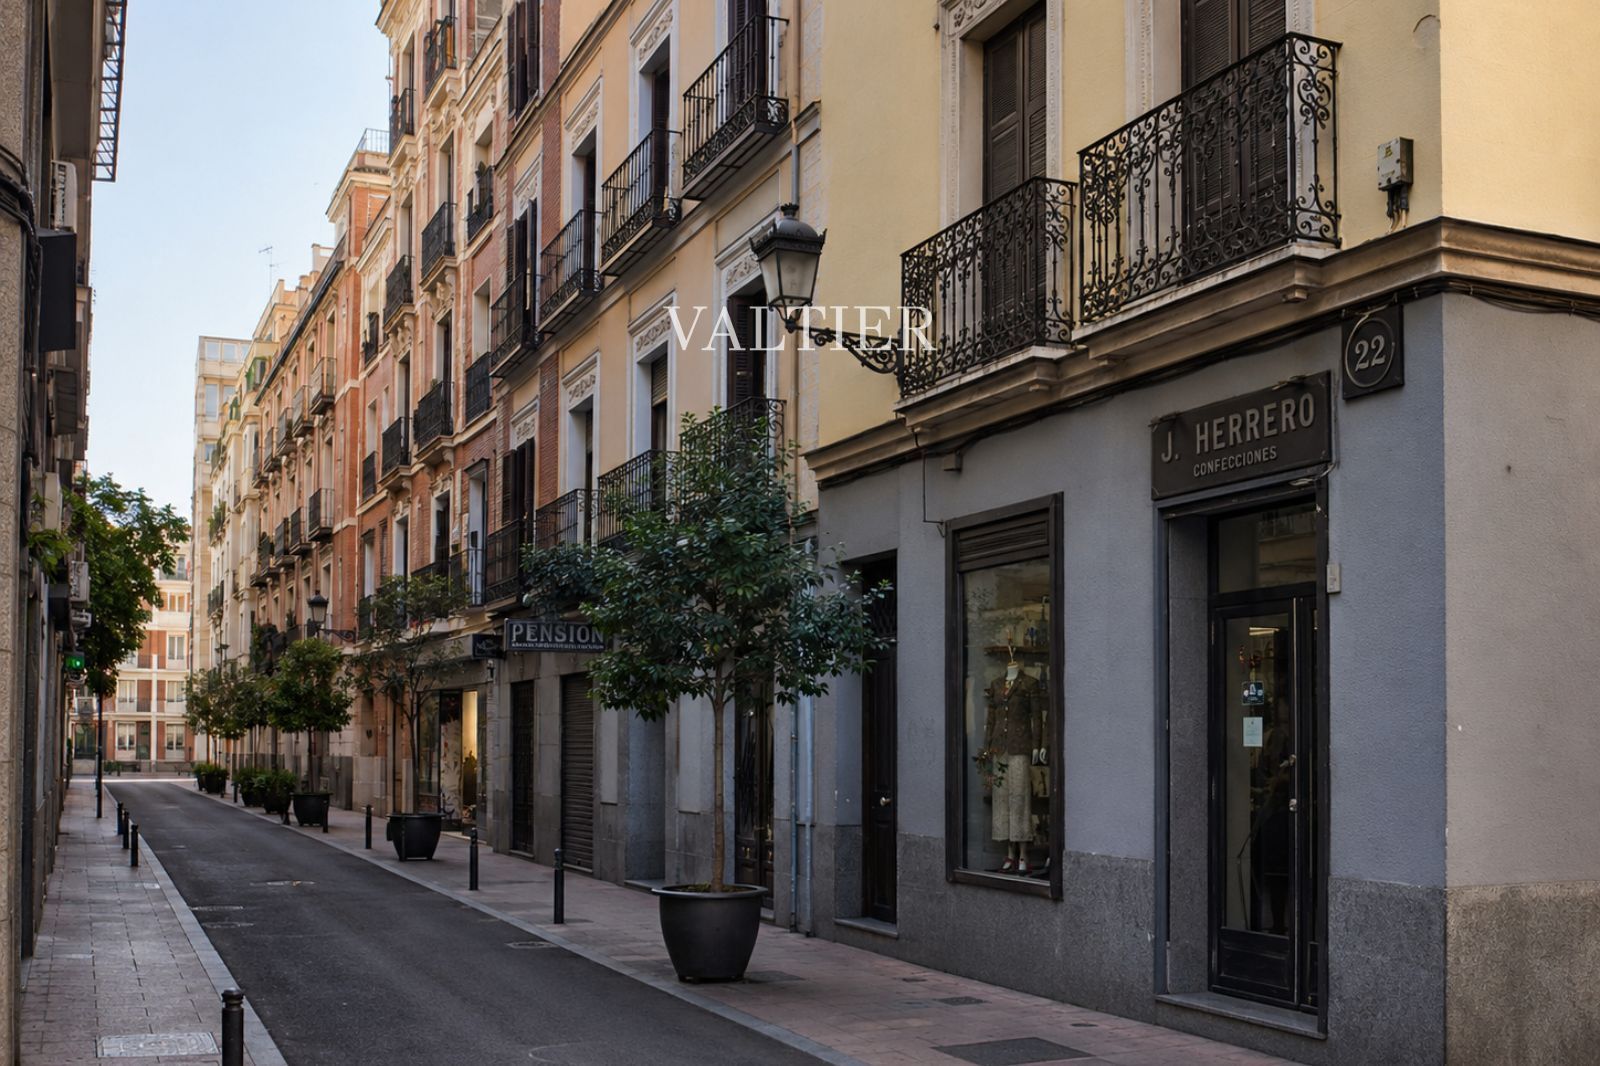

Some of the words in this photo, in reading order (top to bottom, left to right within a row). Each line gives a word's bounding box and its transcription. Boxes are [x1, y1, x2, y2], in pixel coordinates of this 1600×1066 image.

[1354, 335, 1386, 372] 22
[1161, 431, 1180, 463] J.
[1196, 393, 1315, 455] HERRERO
[1193, 446, 1278, 477] CONFECCIONES
[511, 624, 604, 643] PENSION
